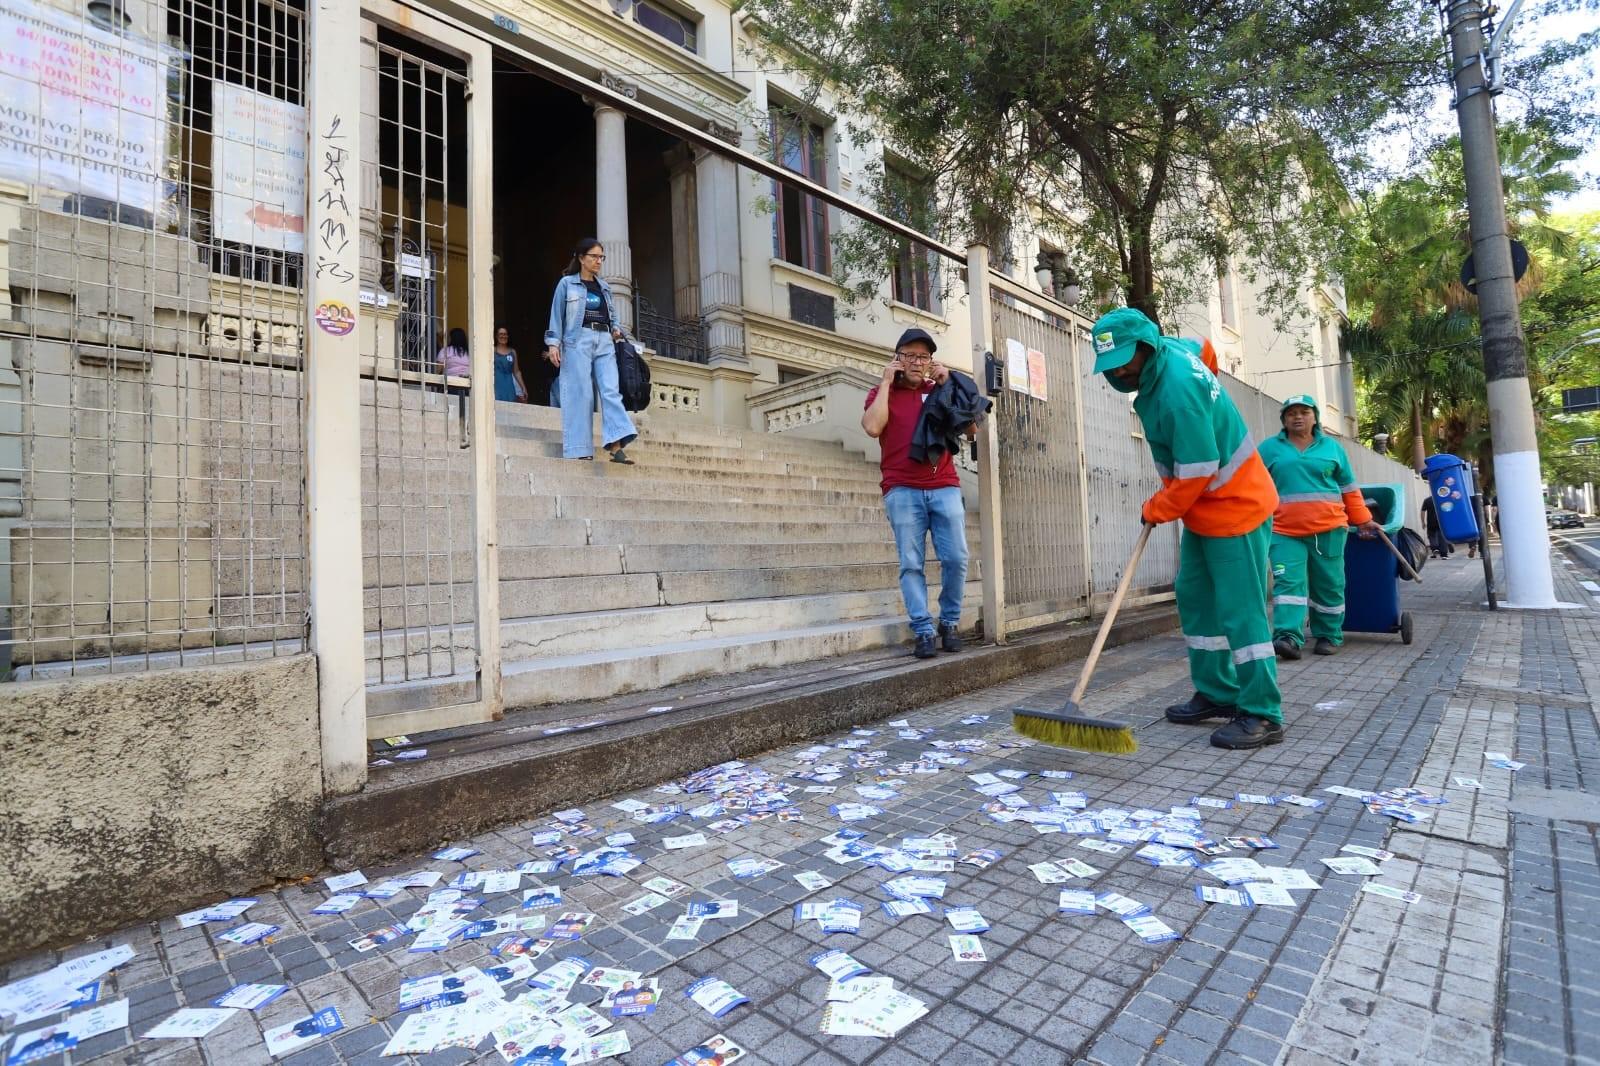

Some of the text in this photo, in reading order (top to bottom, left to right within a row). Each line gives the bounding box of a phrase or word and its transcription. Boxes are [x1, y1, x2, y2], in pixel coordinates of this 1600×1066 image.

[101, 52, 136, 75] NÃO
[129, 95, 152, 108] AO
[84, 127, 145, 154] PRÉDIO
